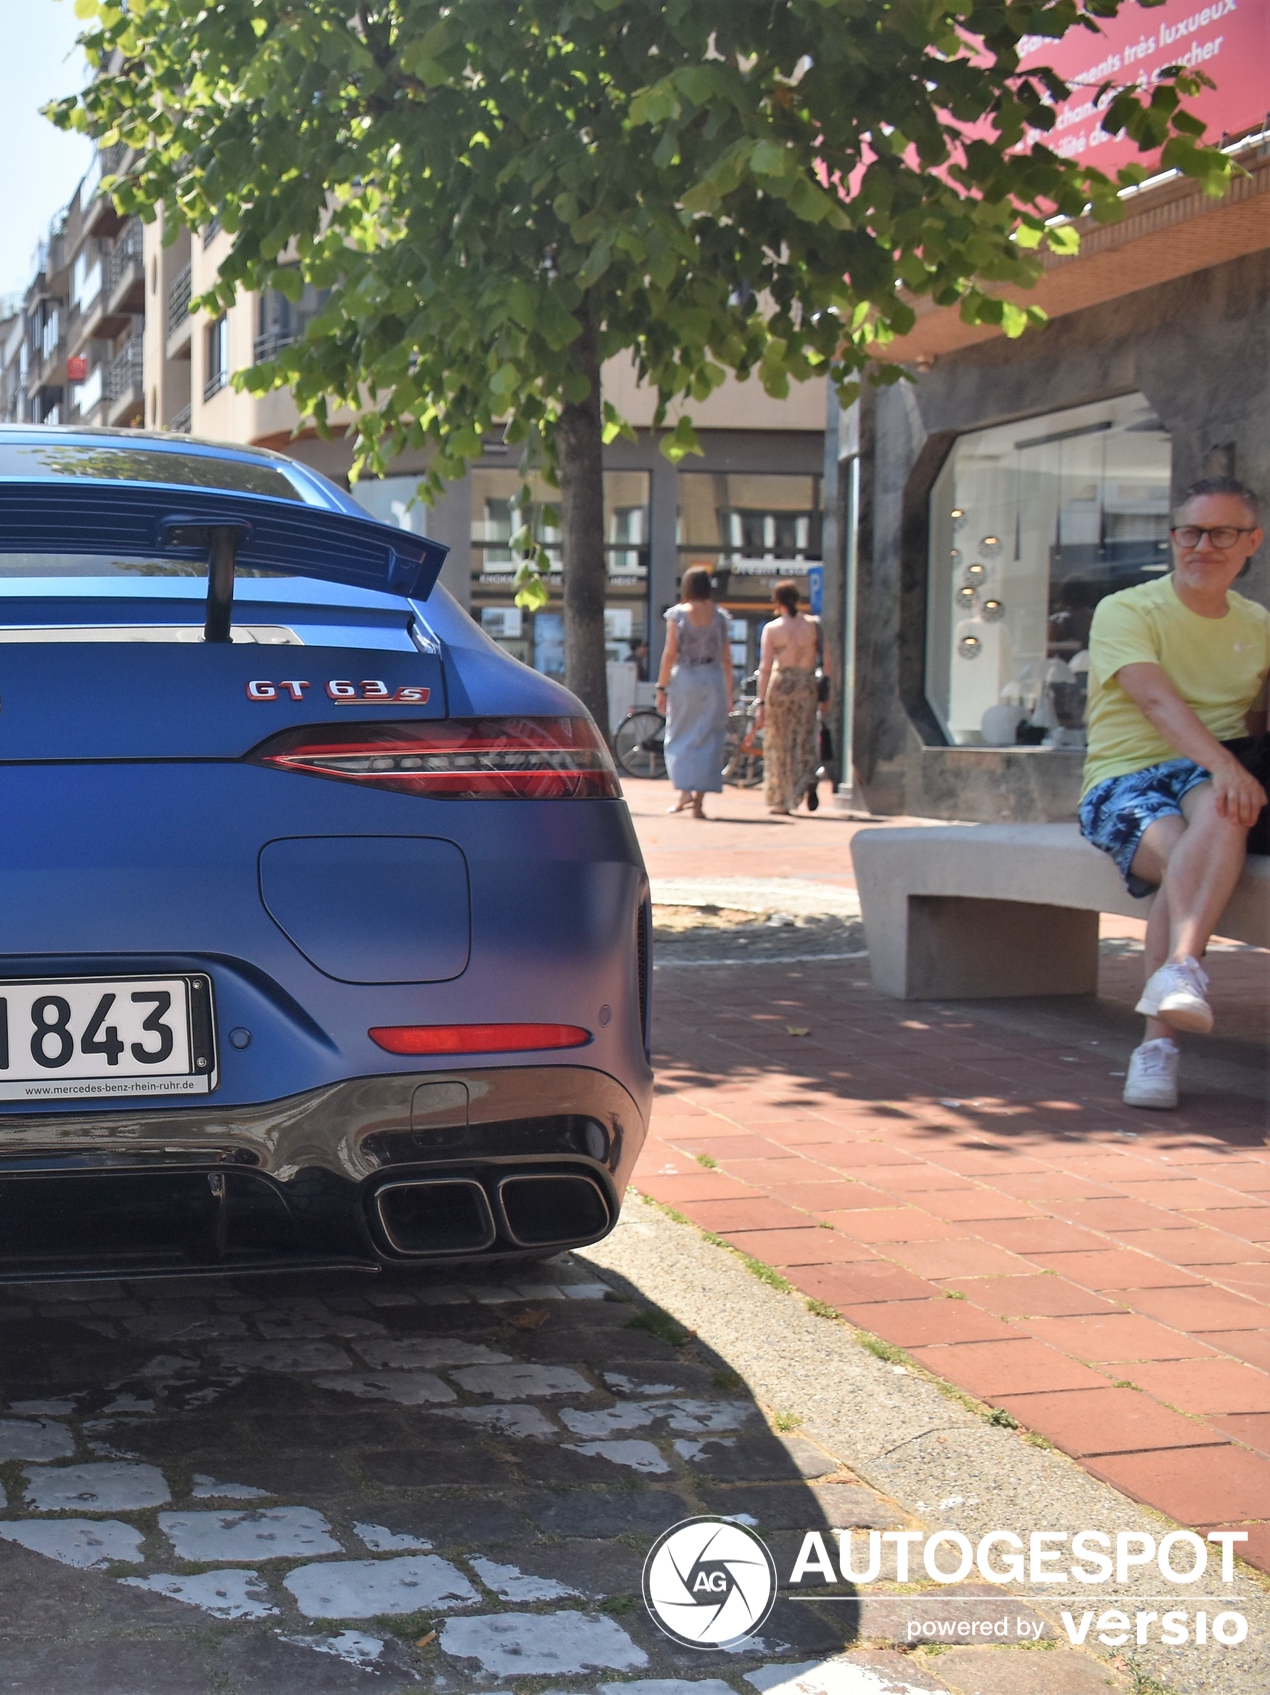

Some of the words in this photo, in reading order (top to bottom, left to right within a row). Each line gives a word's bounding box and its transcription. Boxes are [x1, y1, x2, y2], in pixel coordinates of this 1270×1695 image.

[1123, 35, 1155, 66] très
[1159, 0, 1237, 47] luxueux
[246, 680, 310, 700] GT
[325, 680, 390, 699] 63
[30, 990, 174, 1070] 843
[25, 1080, 194, 1096] www.mercedes-benz-rhein-ruhr.de
